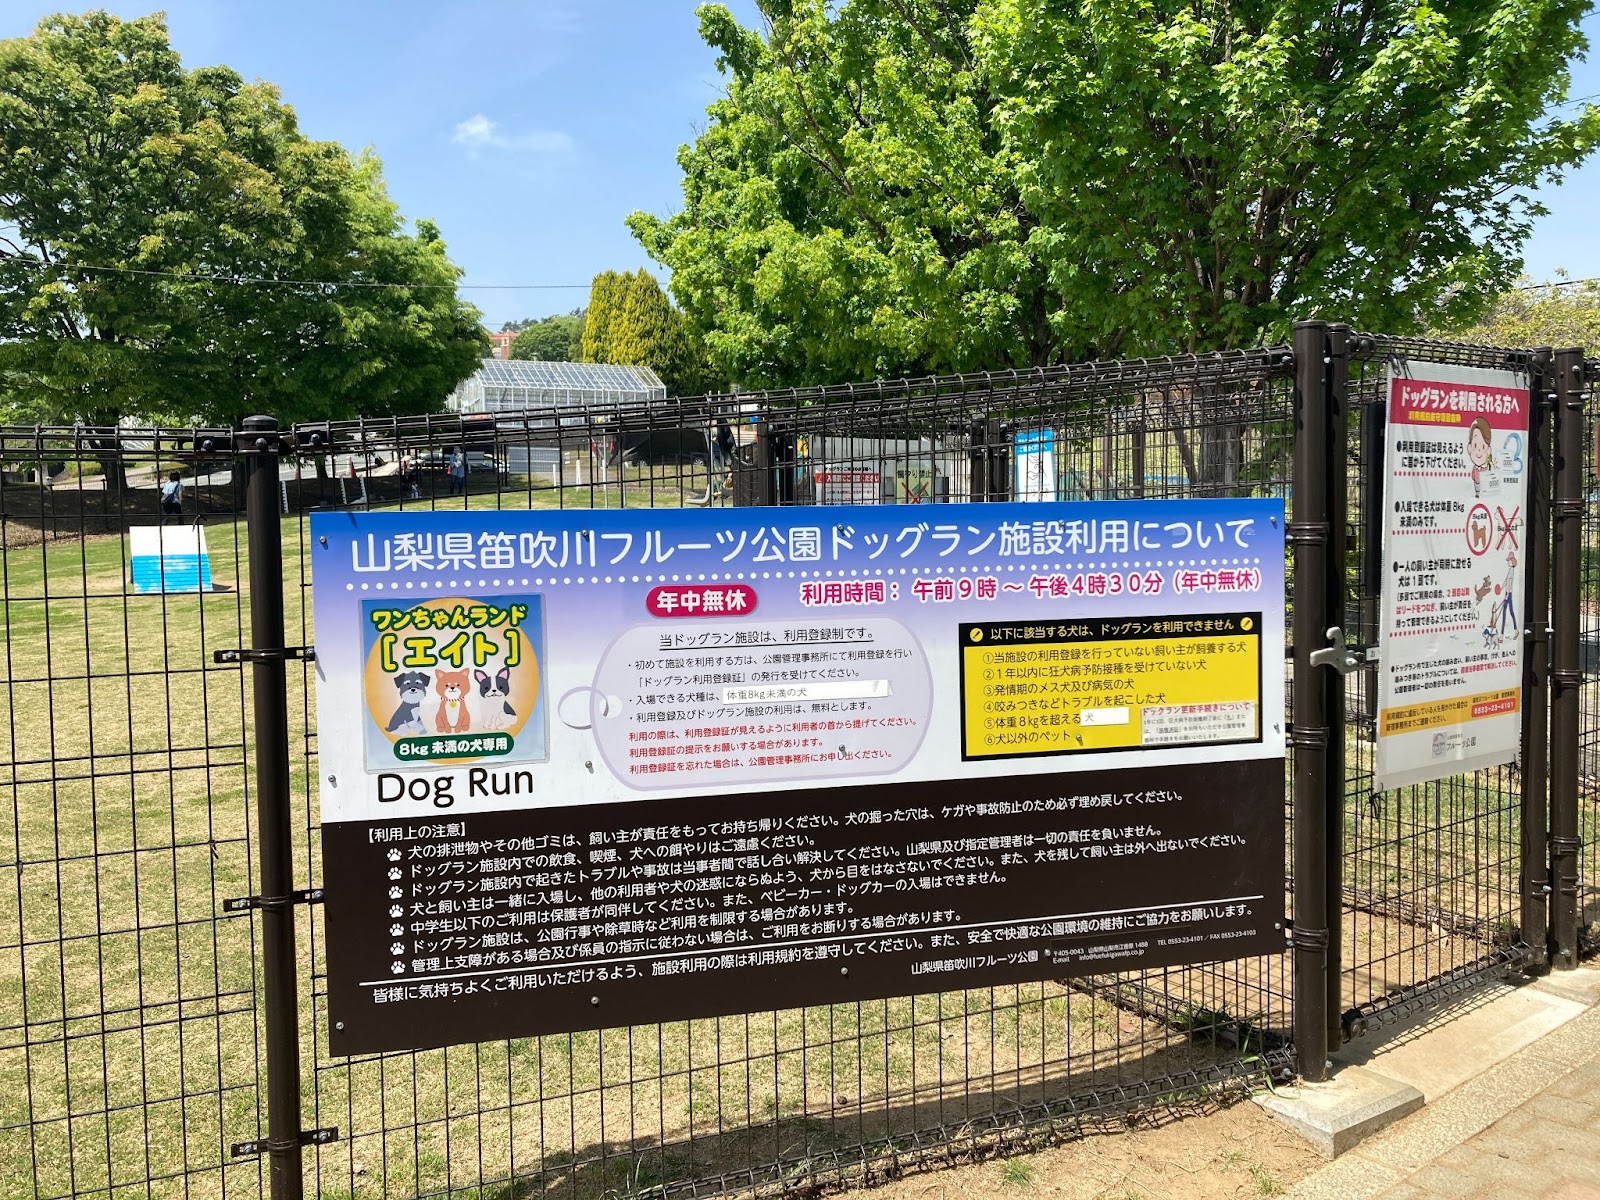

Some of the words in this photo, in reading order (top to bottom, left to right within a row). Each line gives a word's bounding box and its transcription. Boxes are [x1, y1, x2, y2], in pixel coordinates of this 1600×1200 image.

[1401, 385, 1520, 415] ドッグランを利用される方へ
[351, 518, 1256, 574] 山梨県笛吹川フルーツ公園ドッグラン施設利用について
[656, 588, 748, 613] 年中無休
[372, 604, 527, 631] ワンちゃんランド
[990, 619, 1235, 641] 以下に該当する犬は、ドッグランを利用できません
[659, 627, 874, 647] 当ドッグラン施設は、利用登録制です。
[638, 668, 861, 688] 「ドッグラン利用登録証」の発行を受けてください。
[983, 678, 1135, 697] ③発情期のメス犬及び病気の犬
[1084, 712, 1095, 723] 犬
[628, 718, 917, 743] 利用の際は、利用登録証が見えるように利用者の首から提げてください。
[399, 743, 429, 756] 8kg
[629, 737, 823, 759] 利用登録証の提示をお願いする場合があります。
[629, 750, 893, 775] 利用登録証を忘れた場合は、公園管理事務所にお申し出ください。
[377, 773, 454, 808] Dog
[469, 767, 533, 797] Run
[368, 821, 466, 844] 【利用上の注意】
[410, 834, 816, 879] ドッグラン施設内での飲食、喫煙、犬への餌やりはご遠慮ください。
[410, 871, 1007, 936] 中学生以下のご利用は保護者が同伴してください。また、ベビーカー・ドッグカーの入場はできません。
[413, 901, 854, 954] ドッグラン施設は、公園行事や除草時など利用を制限する場合があります。
[411, 909, 962, 973] 管理上支障がある場合及び係員の指示に従わない場合は、ご利用をお断りする場合があります。
[911, 950, 1039, 975] 山梨県笛吹川フルーツ公園
